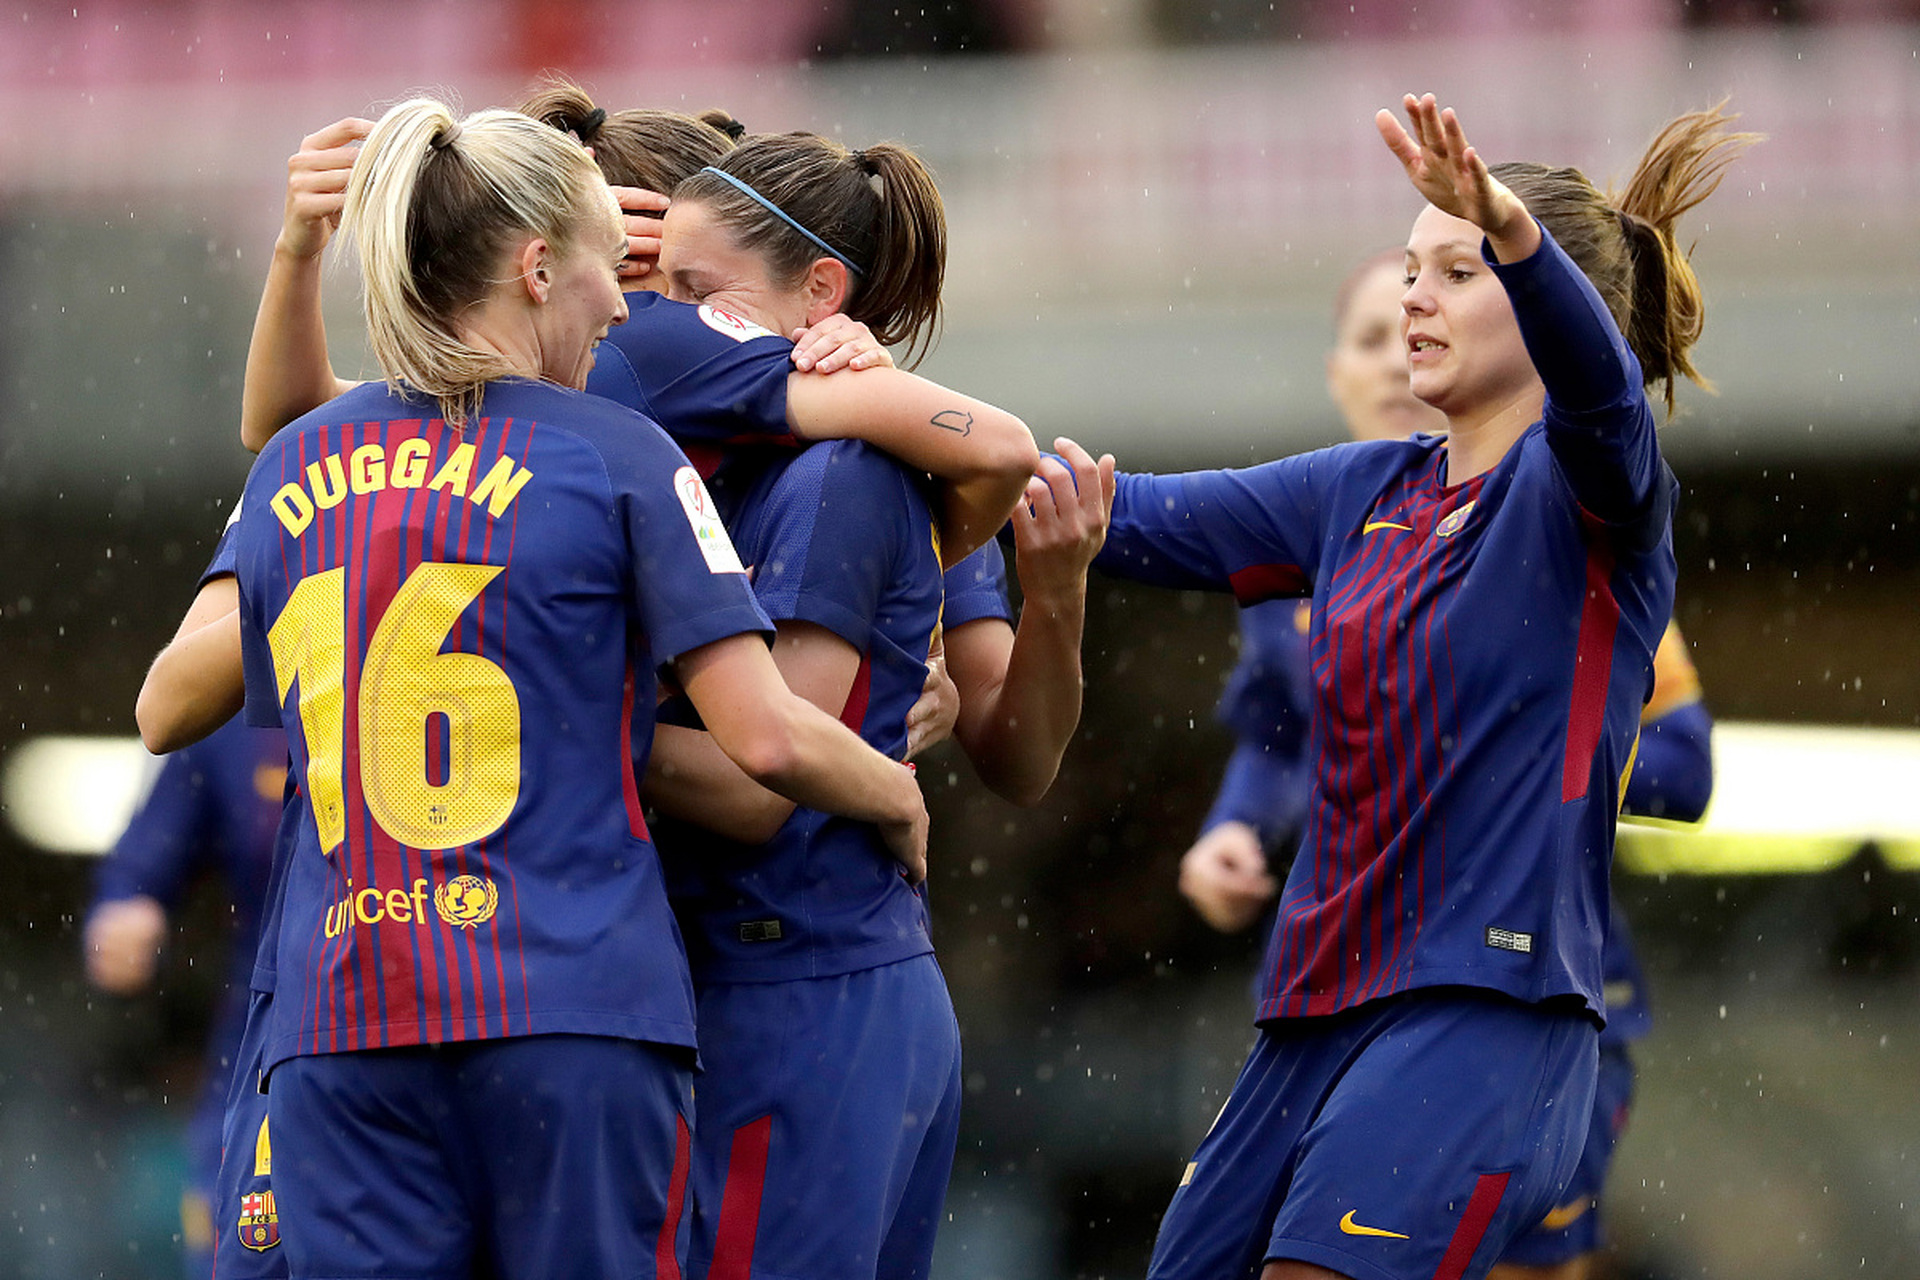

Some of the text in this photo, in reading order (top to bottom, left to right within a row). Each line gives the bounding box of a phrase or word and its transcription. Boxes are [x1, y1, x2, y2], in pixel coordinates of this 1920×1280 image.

[269, 437, 534, 539] DUGGAN
[267, 562, 521, 856] 16
[324, 877, 428, 938] unicef
